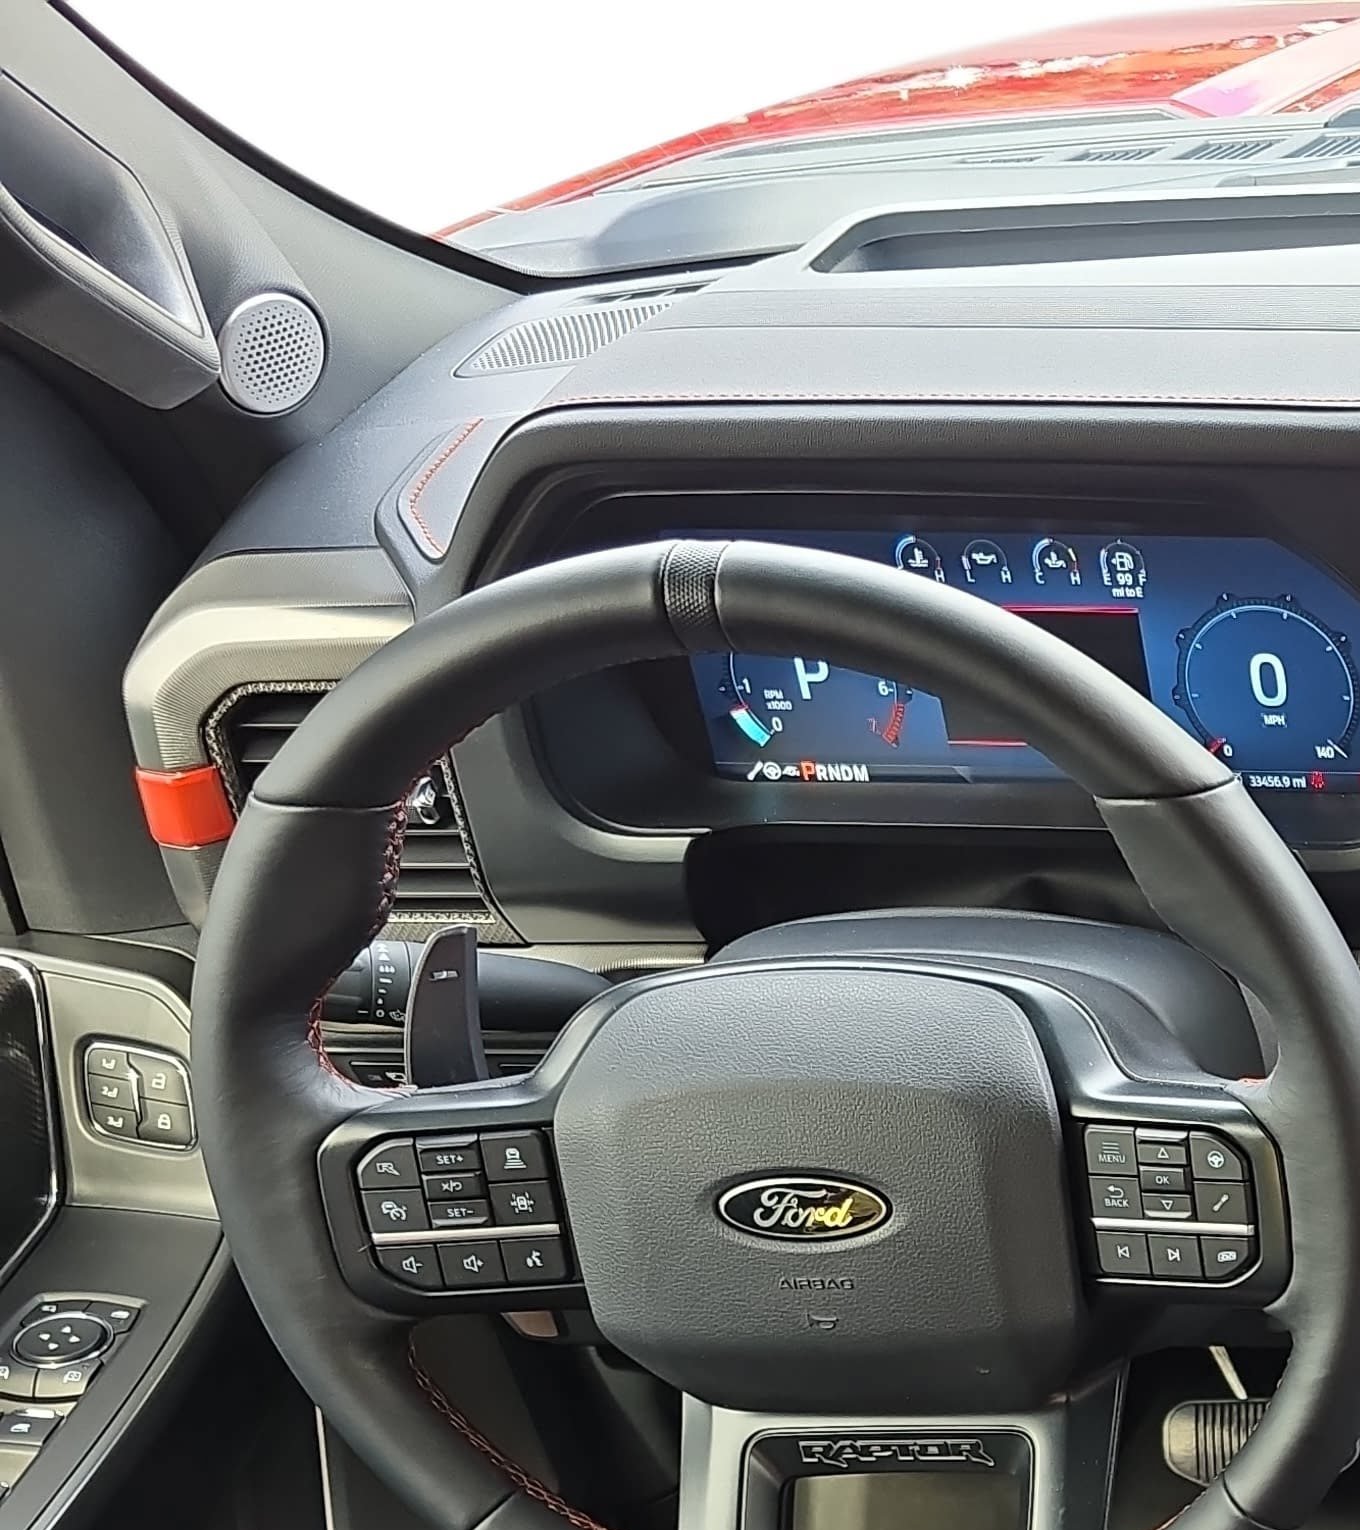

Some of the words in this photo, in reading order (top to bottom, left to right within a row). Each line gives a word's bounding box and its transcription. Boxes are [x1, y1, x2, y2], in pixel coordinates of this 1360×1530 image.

[967, 570, 976, 583] L
[1001, 570, 1012, 583] H
[1035, 571, 1045, 584] C
[1071, 572, 1081, 585] H
[1103, 574, 1112, 586] E
[1117, 574, 1133, 586] 99
[1138, 574, 1147, 586] F
[1250, 652, 1287, 707] 0
[764, 689, 783, 699] RPM
[772, 716, 783, 732] 0
[1263, 715, 1285, 726] MPH
[1223, 745, 1232, 757] 0
[1315, 746, 1335, 759] 140
[1098, 1154, 1126, 1164] MENU
[1155, 1175, 1170, 1185] OK
[753, 1188, 854, 1229] Ford
[1104, 1198, 1129, 1208] BACK
[779, 1277, 856, 1291] AIRBAG
[798, 1439, 995, 1468] RAPTOR
